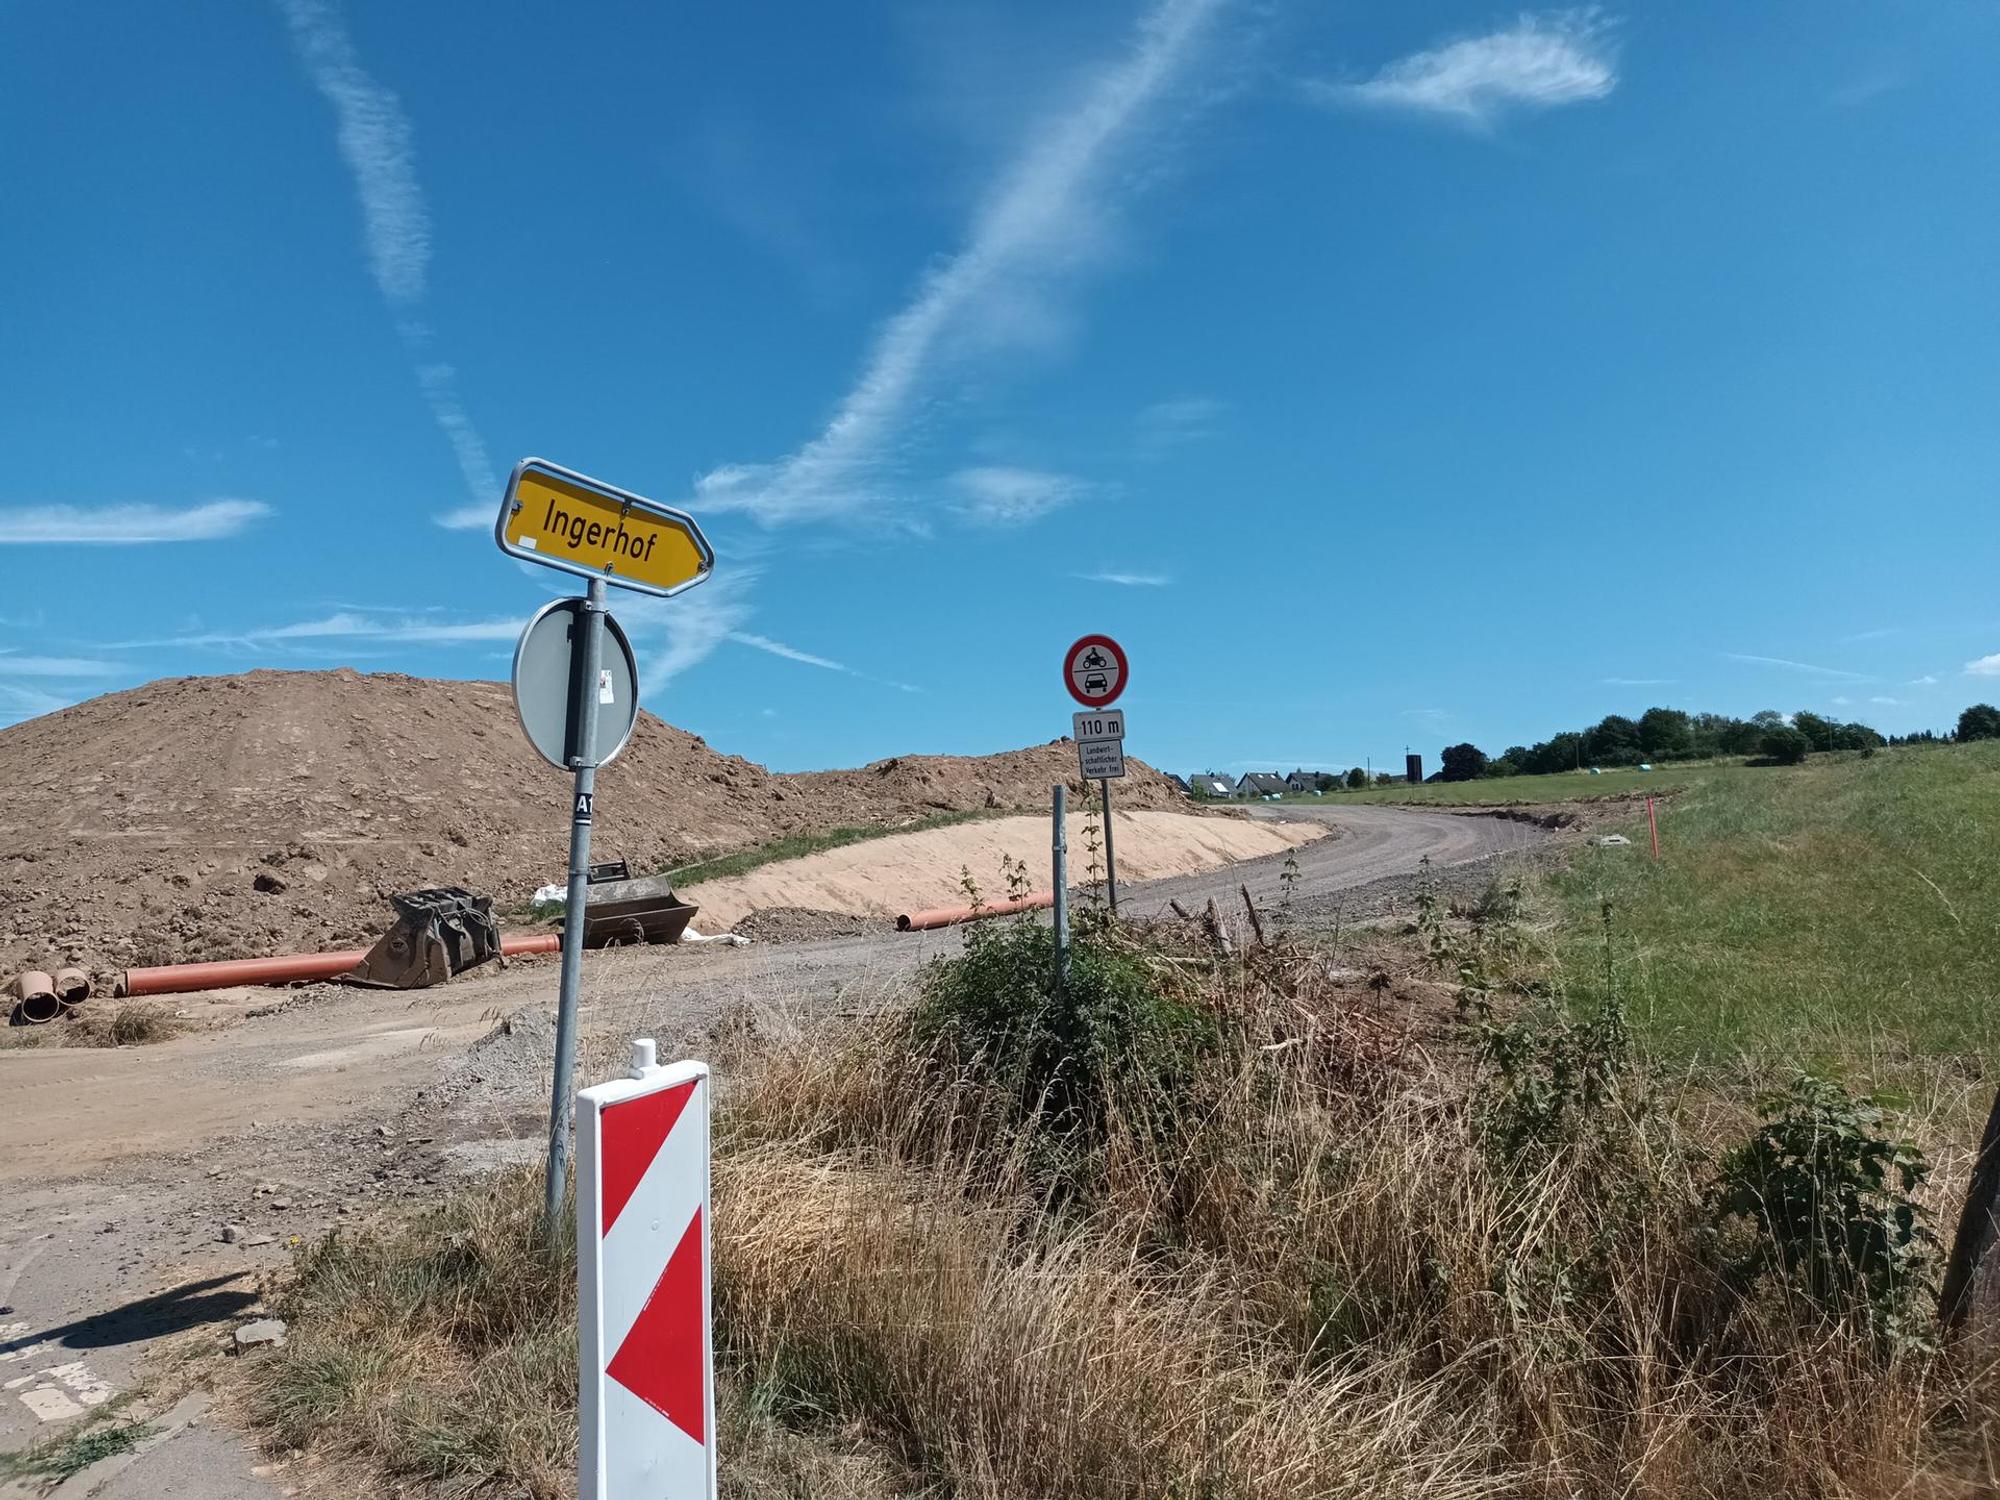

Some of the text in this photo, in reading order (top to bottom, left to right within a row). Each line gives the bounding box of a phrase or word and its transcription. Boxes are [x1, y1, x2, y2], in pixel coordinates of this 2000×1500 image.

[543, 499, 658, 562] Ingerhof
[1082, 720, 1119, 735] 110 m
